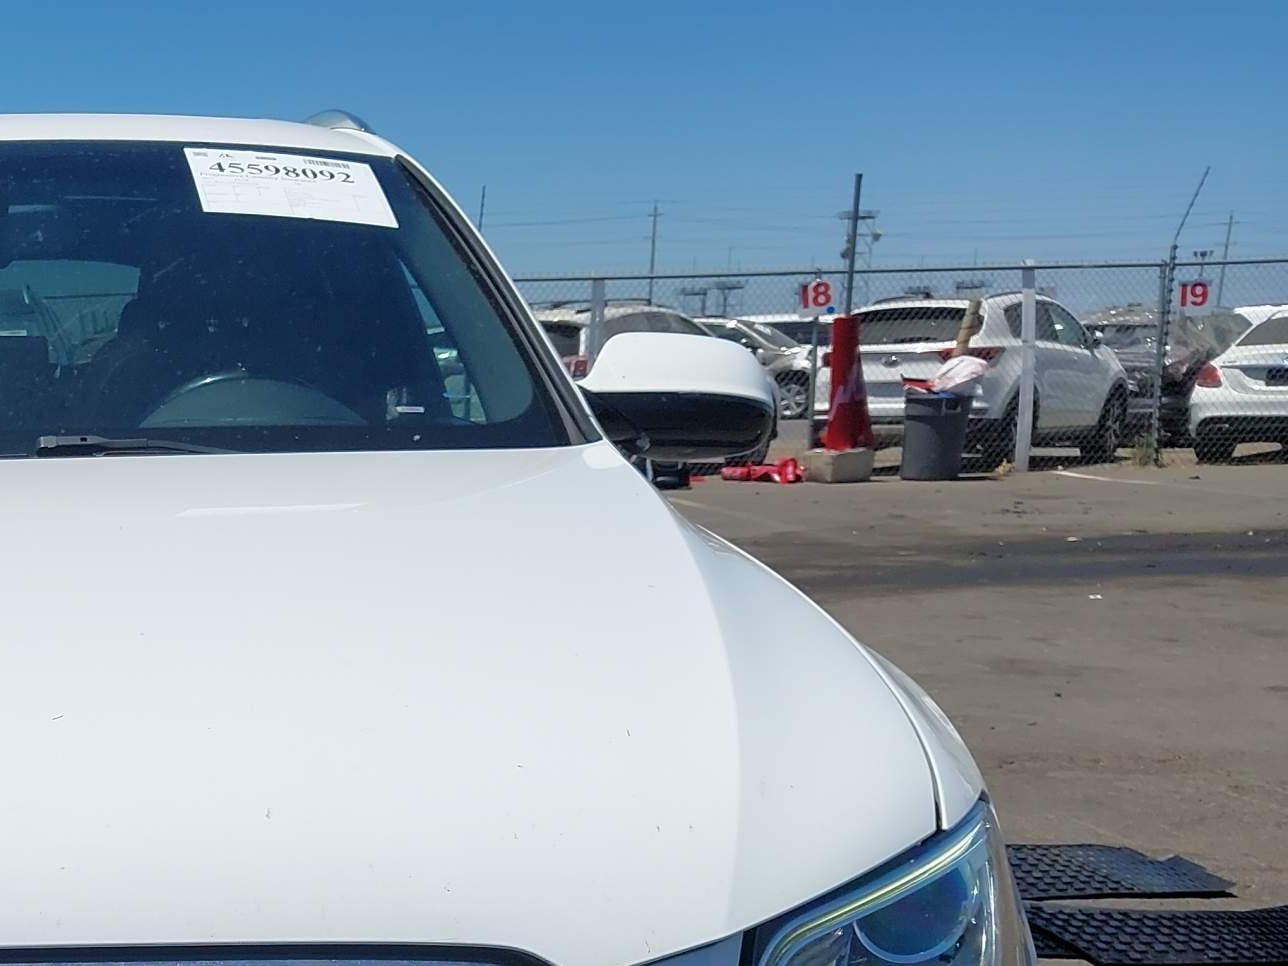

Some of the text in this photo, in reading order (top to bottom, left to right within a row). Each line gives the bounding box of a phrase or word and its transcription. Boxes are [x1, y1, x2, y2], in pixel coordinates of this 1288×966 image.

[209, 161, 355, 183] 45598092
[802, 282, 831, 308] 18
[1181, 283, 1208, 306] 19
